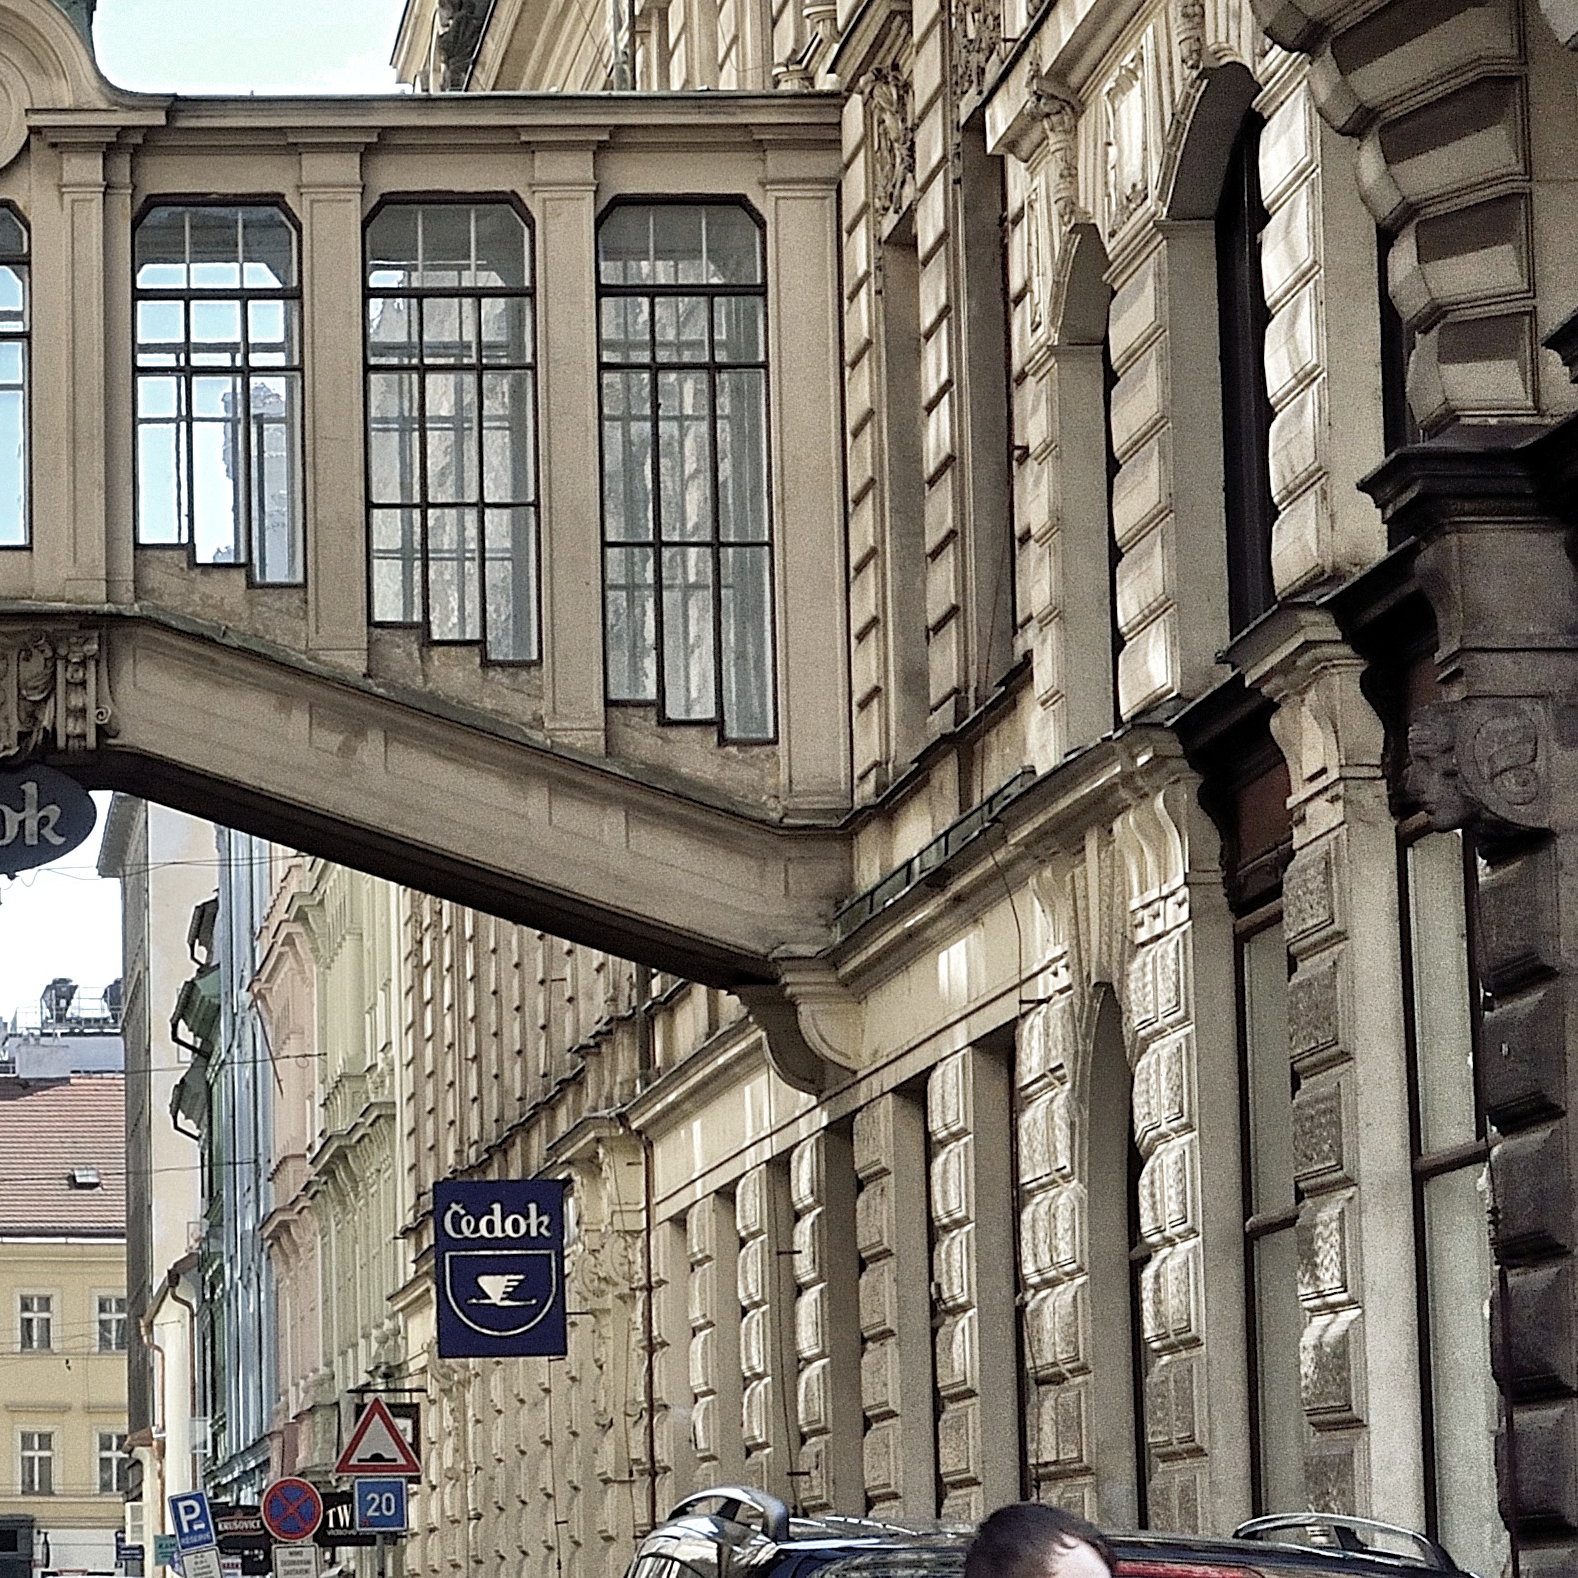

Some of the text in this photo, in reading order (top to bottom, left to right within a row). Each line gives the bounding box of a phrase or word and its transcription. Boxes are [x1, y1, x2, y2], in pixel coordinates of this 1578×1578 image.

[443, 1201, 553, 1239] Čedok
[177, 1499, 201, 1534] P
[365, 1492, 396, 1517] 20
[217, 1519, 262, 1532] KRUŠOVICE
